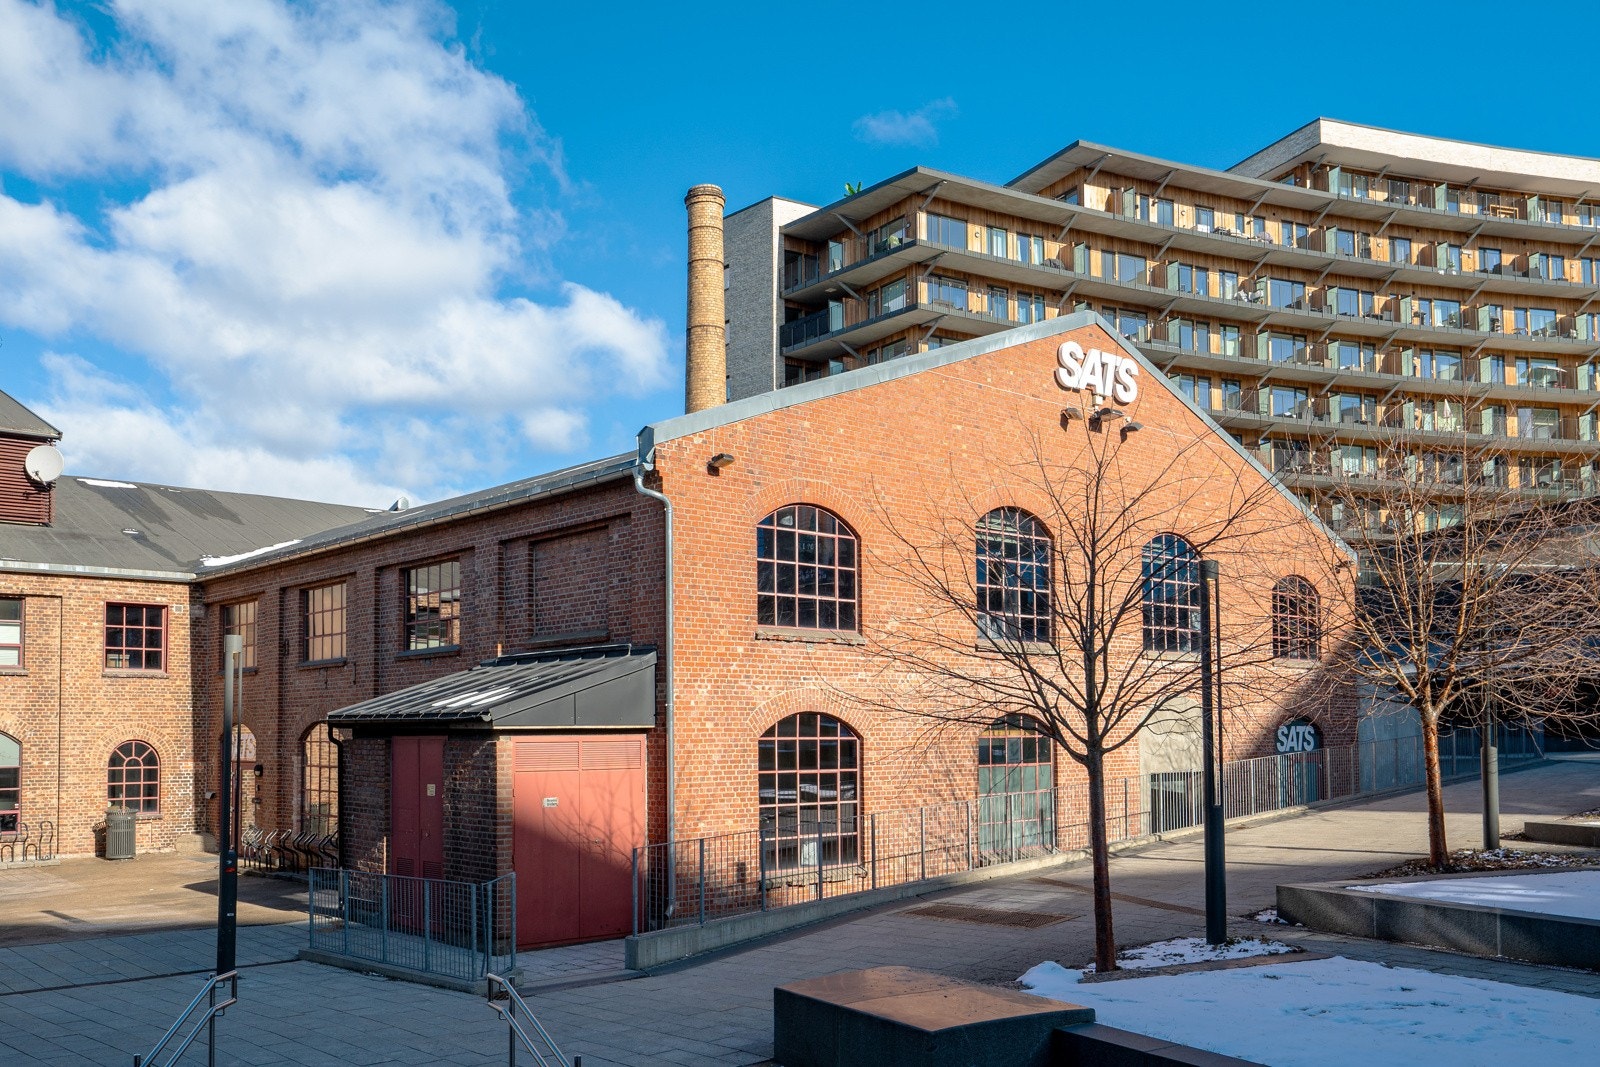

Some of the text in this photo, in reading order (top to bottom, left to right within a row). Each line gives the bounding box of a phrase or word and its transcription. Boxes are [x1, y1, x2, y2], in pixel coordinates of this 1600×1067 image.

[1055, 341, 1139, 404] SATS
[231, 733, 257, 758] ATS
[1276, 725, 1315, 752] SATS
